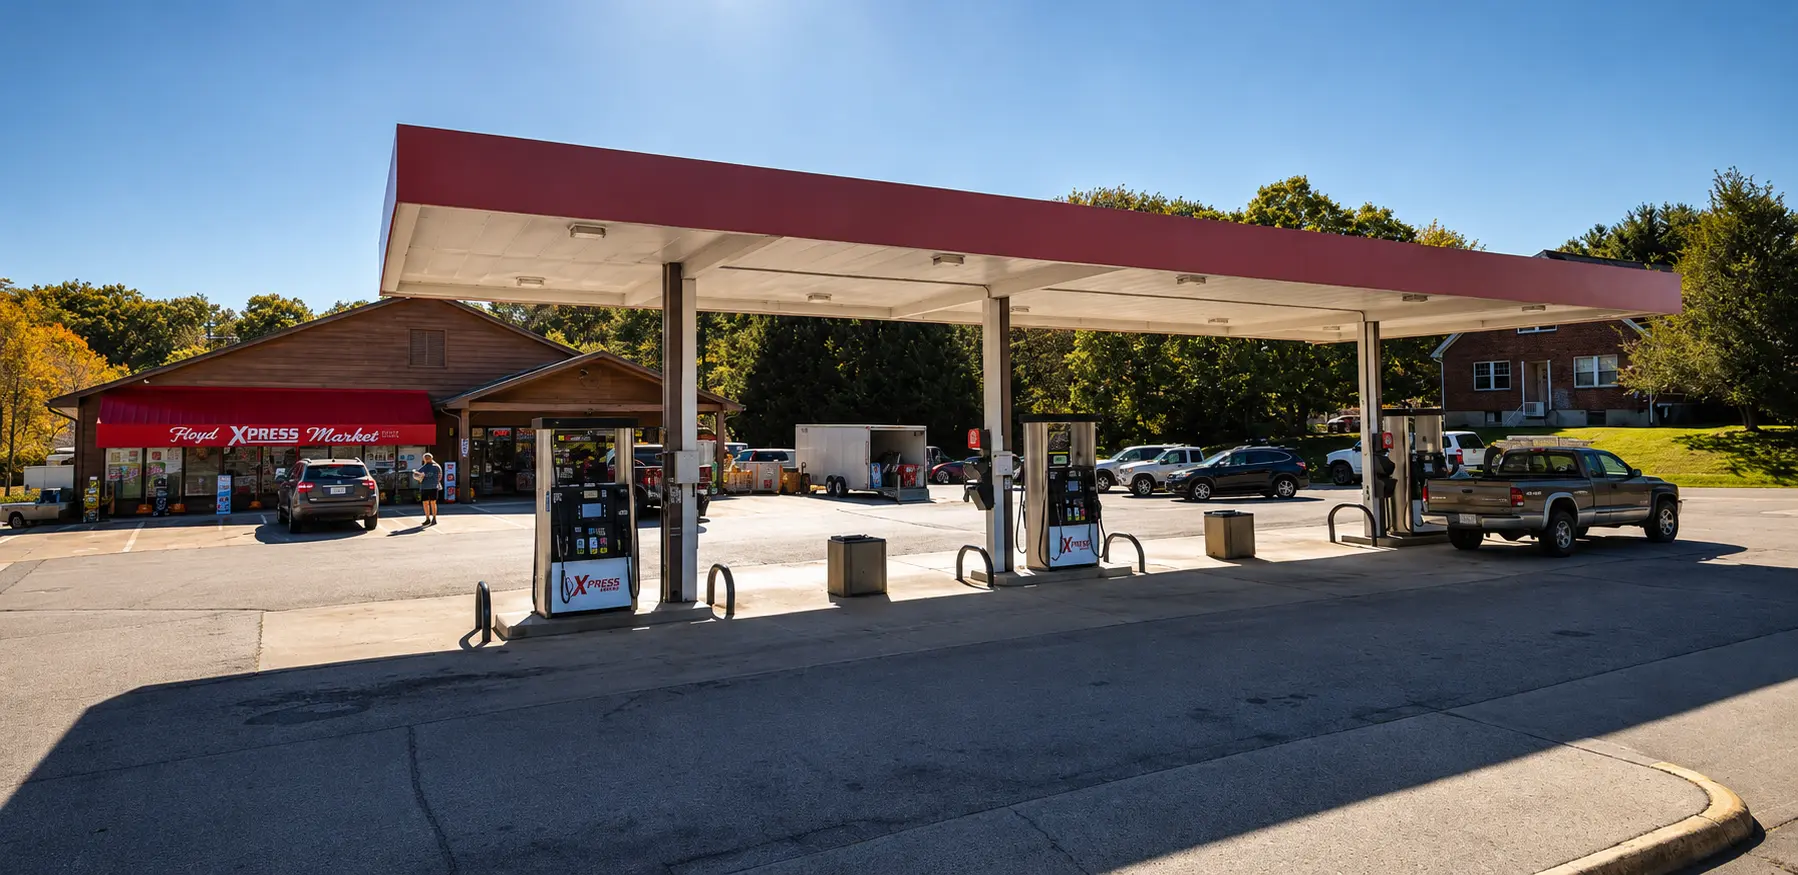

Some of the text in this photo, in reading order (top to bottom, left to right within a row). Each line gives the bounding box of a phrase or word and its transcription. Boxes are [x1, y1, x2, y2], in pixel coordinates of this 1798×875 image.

[169, 426, 220, 443] Floyd
[227, 425, 299, 446] XPRESS
[306, 427, 380, 443] Market
[572, 574, 620, 596] XPRESS
